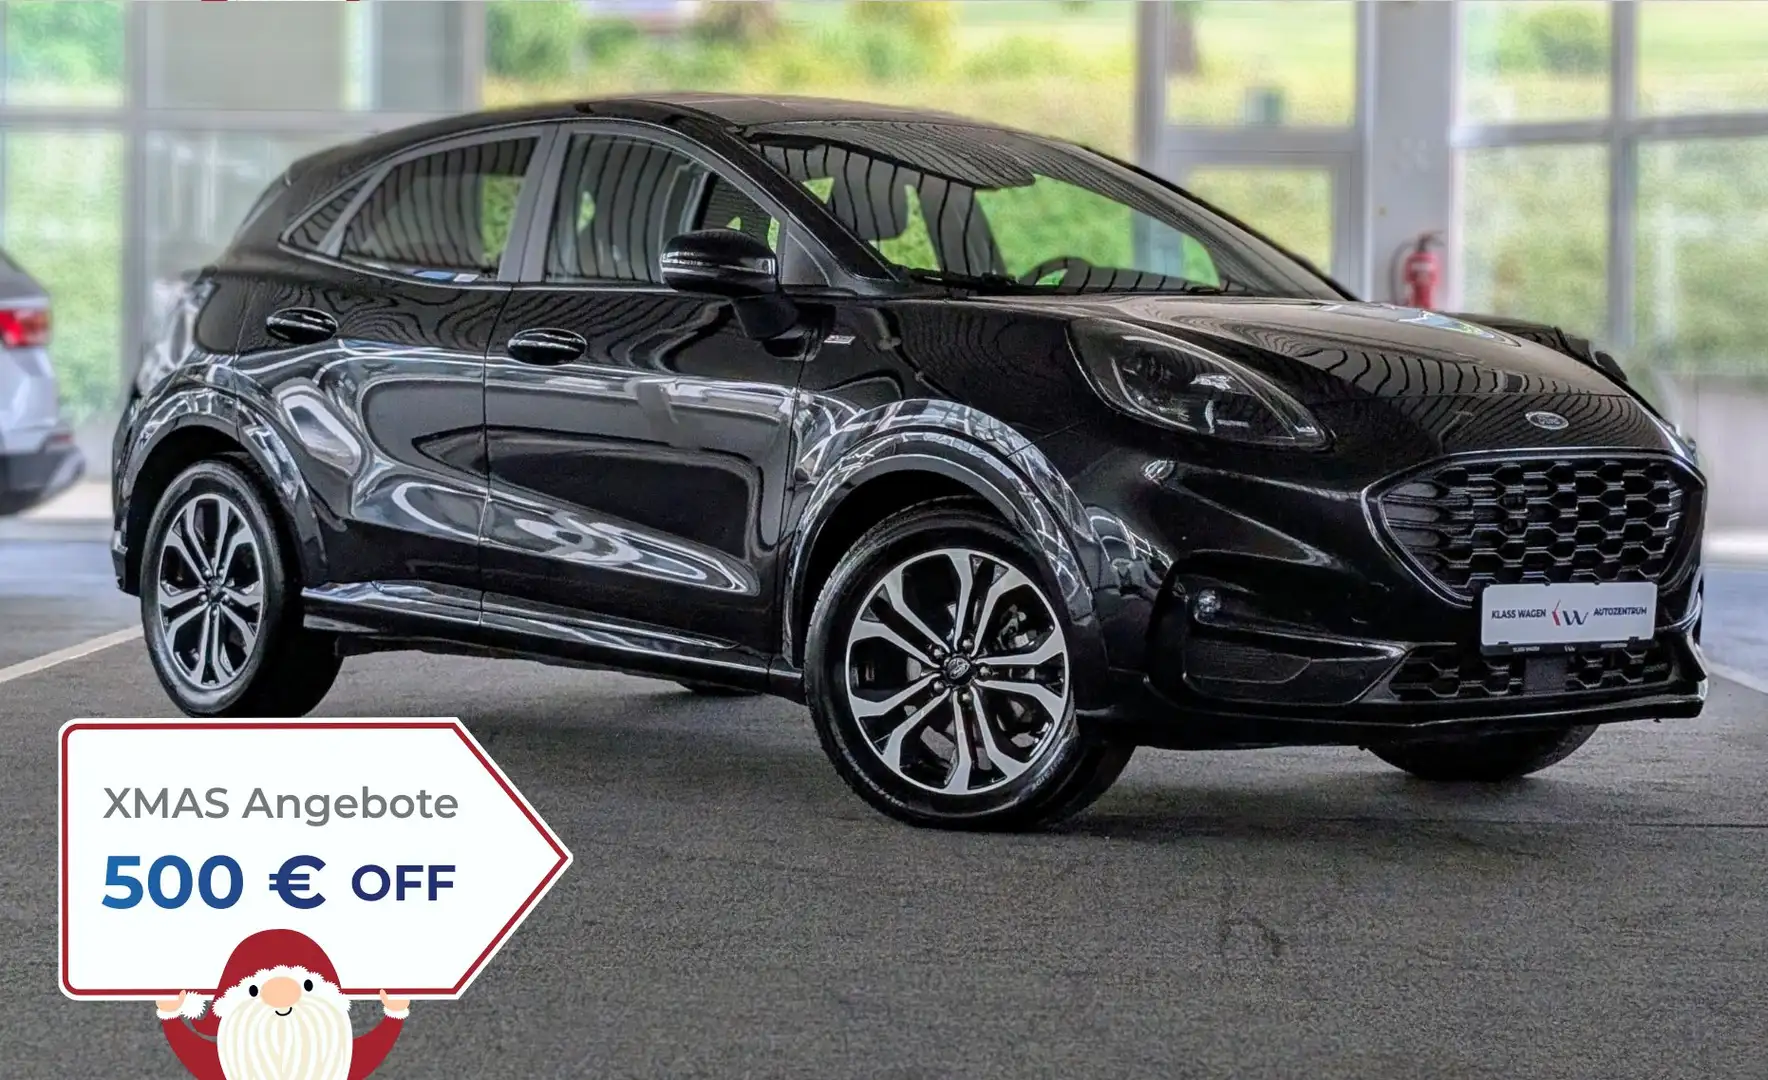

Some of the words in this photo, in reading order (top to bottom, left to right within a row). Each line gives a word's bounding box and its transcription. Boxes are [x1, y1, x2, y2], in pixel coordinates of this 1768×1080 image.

[1491, 609, 1517, 619] KLASS
[1517, 608, 1547, 618] WAGEN
[1593, 606, 1648, 617] AUTOZENTRUM
